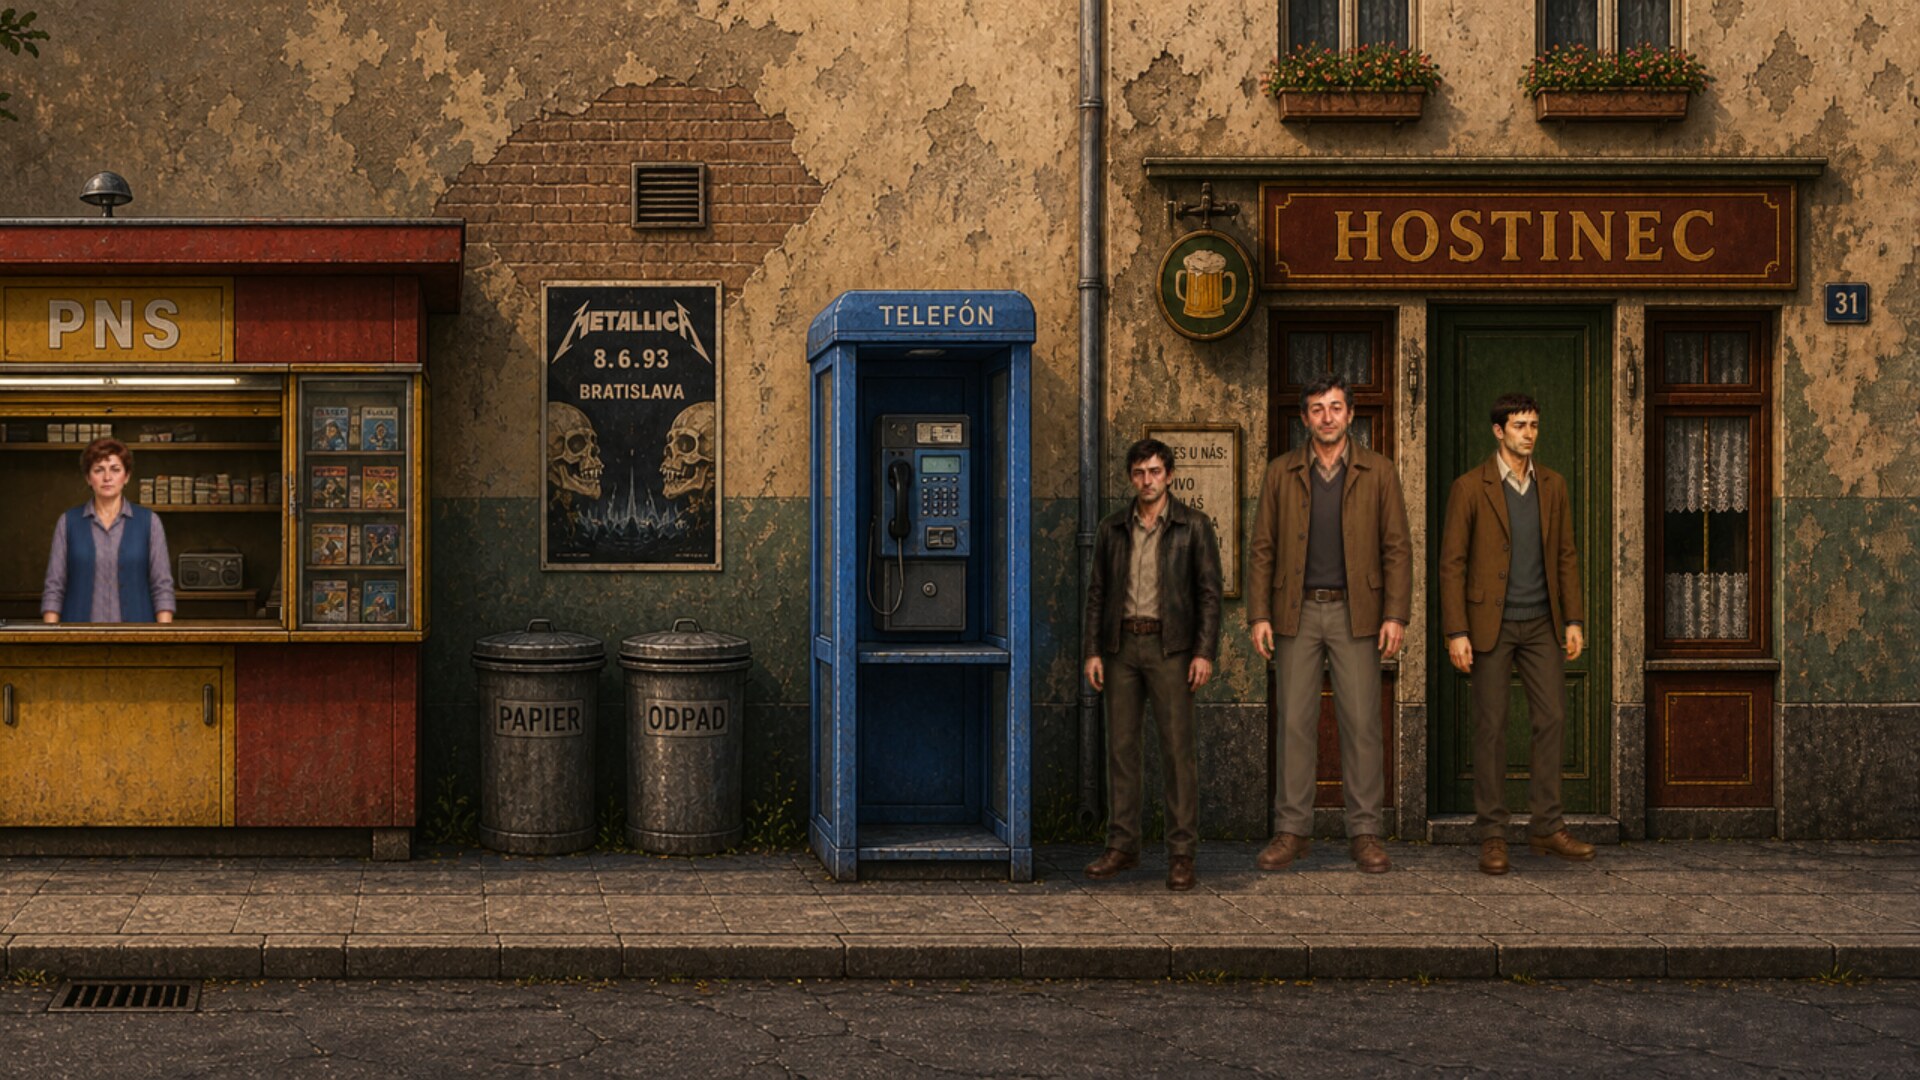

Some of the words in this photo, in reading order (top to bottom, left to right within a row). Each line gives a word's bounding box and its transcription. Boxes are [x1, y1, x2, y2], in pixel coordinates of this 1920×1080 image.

[1334, 209, 1716, 263] HOSTINEC
[878, 299, 994, 326] TELEFÓN
[1835, 291, 1859, 315] 31
[47, 298, 181, 350] PNS
[551, 299, 713, 365] METALLICA
[593, 348, 670, 369] 8.6.93
[579, 383, 685, 400] BRATISLAVA
[1172, 446, 1187, 460] ES
[1189, 446, 1198, 460] U
[1201, 442, 1228, 460] NÁS:
[500, 705, 581, 732] PAPIER
[649, 705, 726, 731] ODPAD
